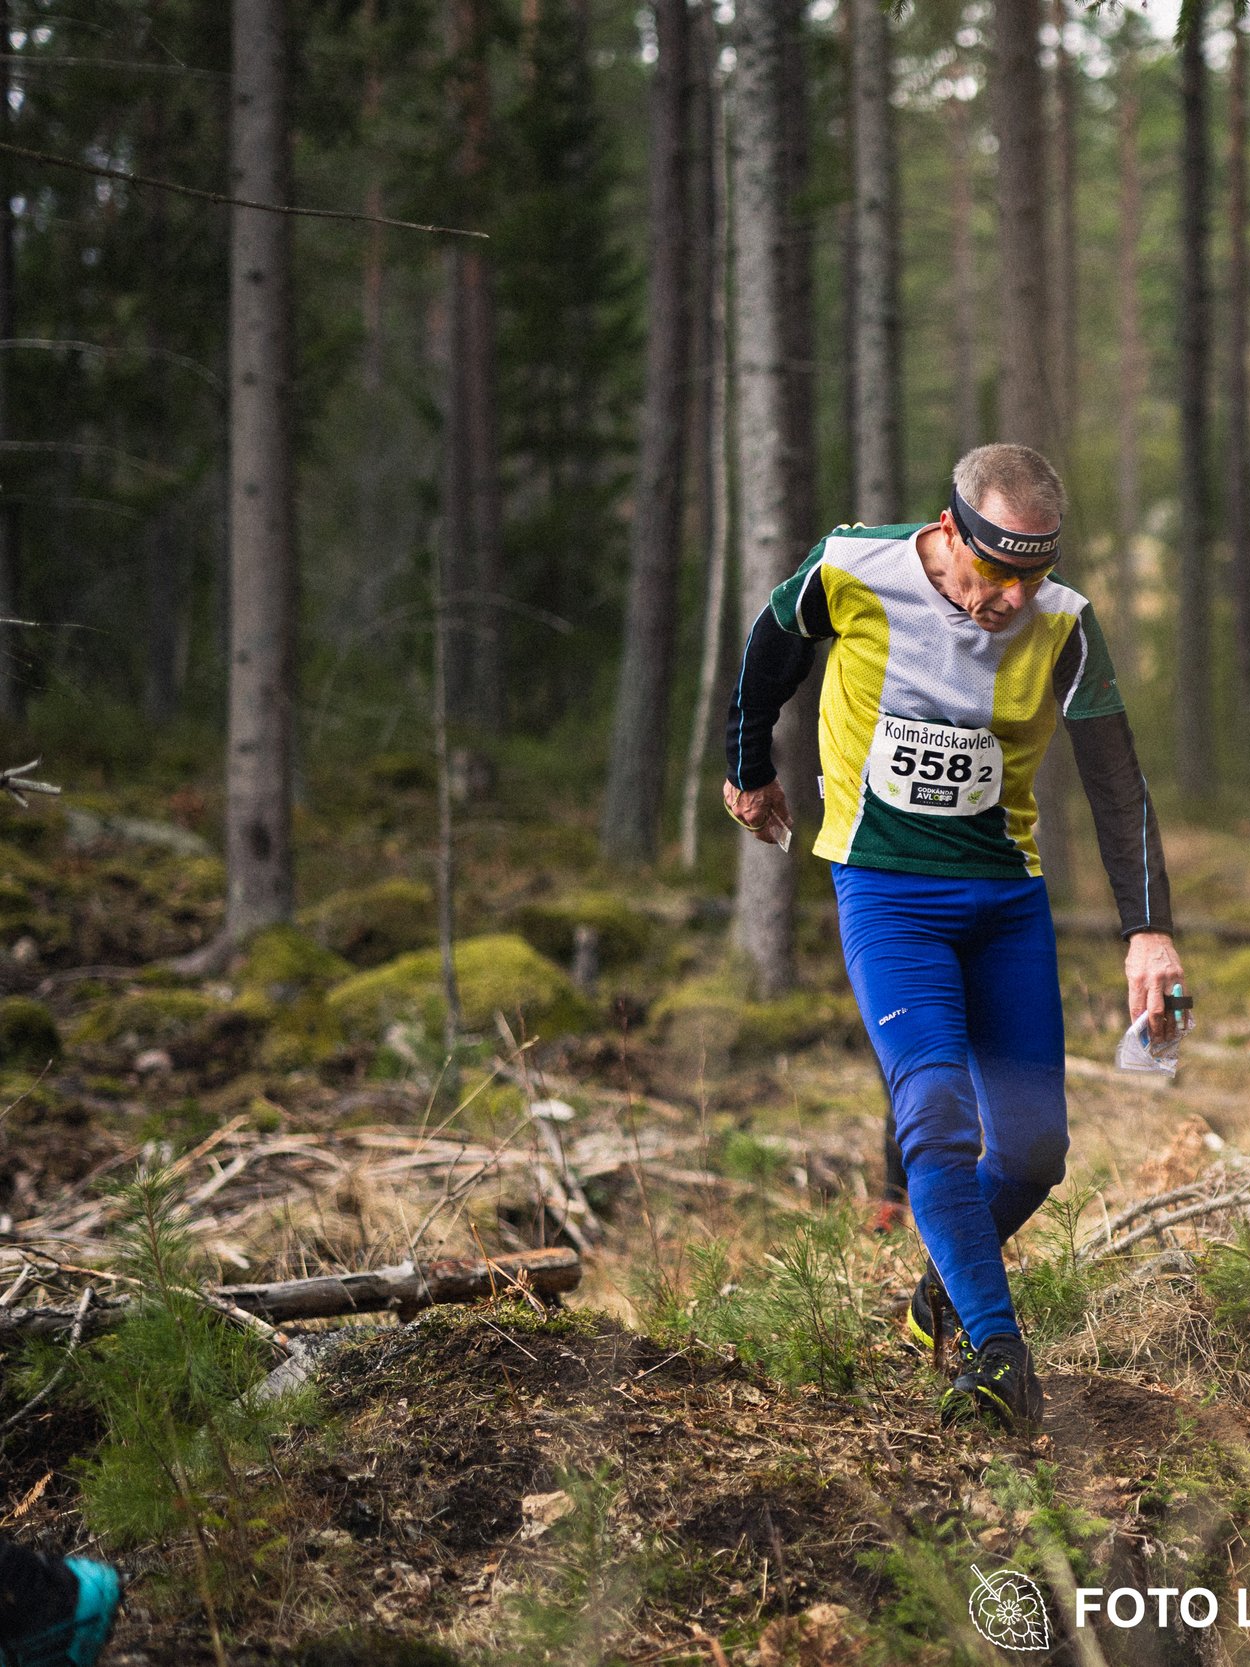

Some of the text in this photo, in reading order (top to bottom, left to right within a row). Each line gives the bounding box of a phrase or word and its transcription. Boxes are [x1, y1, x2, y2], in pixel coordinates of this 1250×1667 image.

[885, 720, 995, 750] Kolmårdskavlen
[891, 745, 993, 783] 558 2
[879, 1009, 901, 1025] CRAFT
